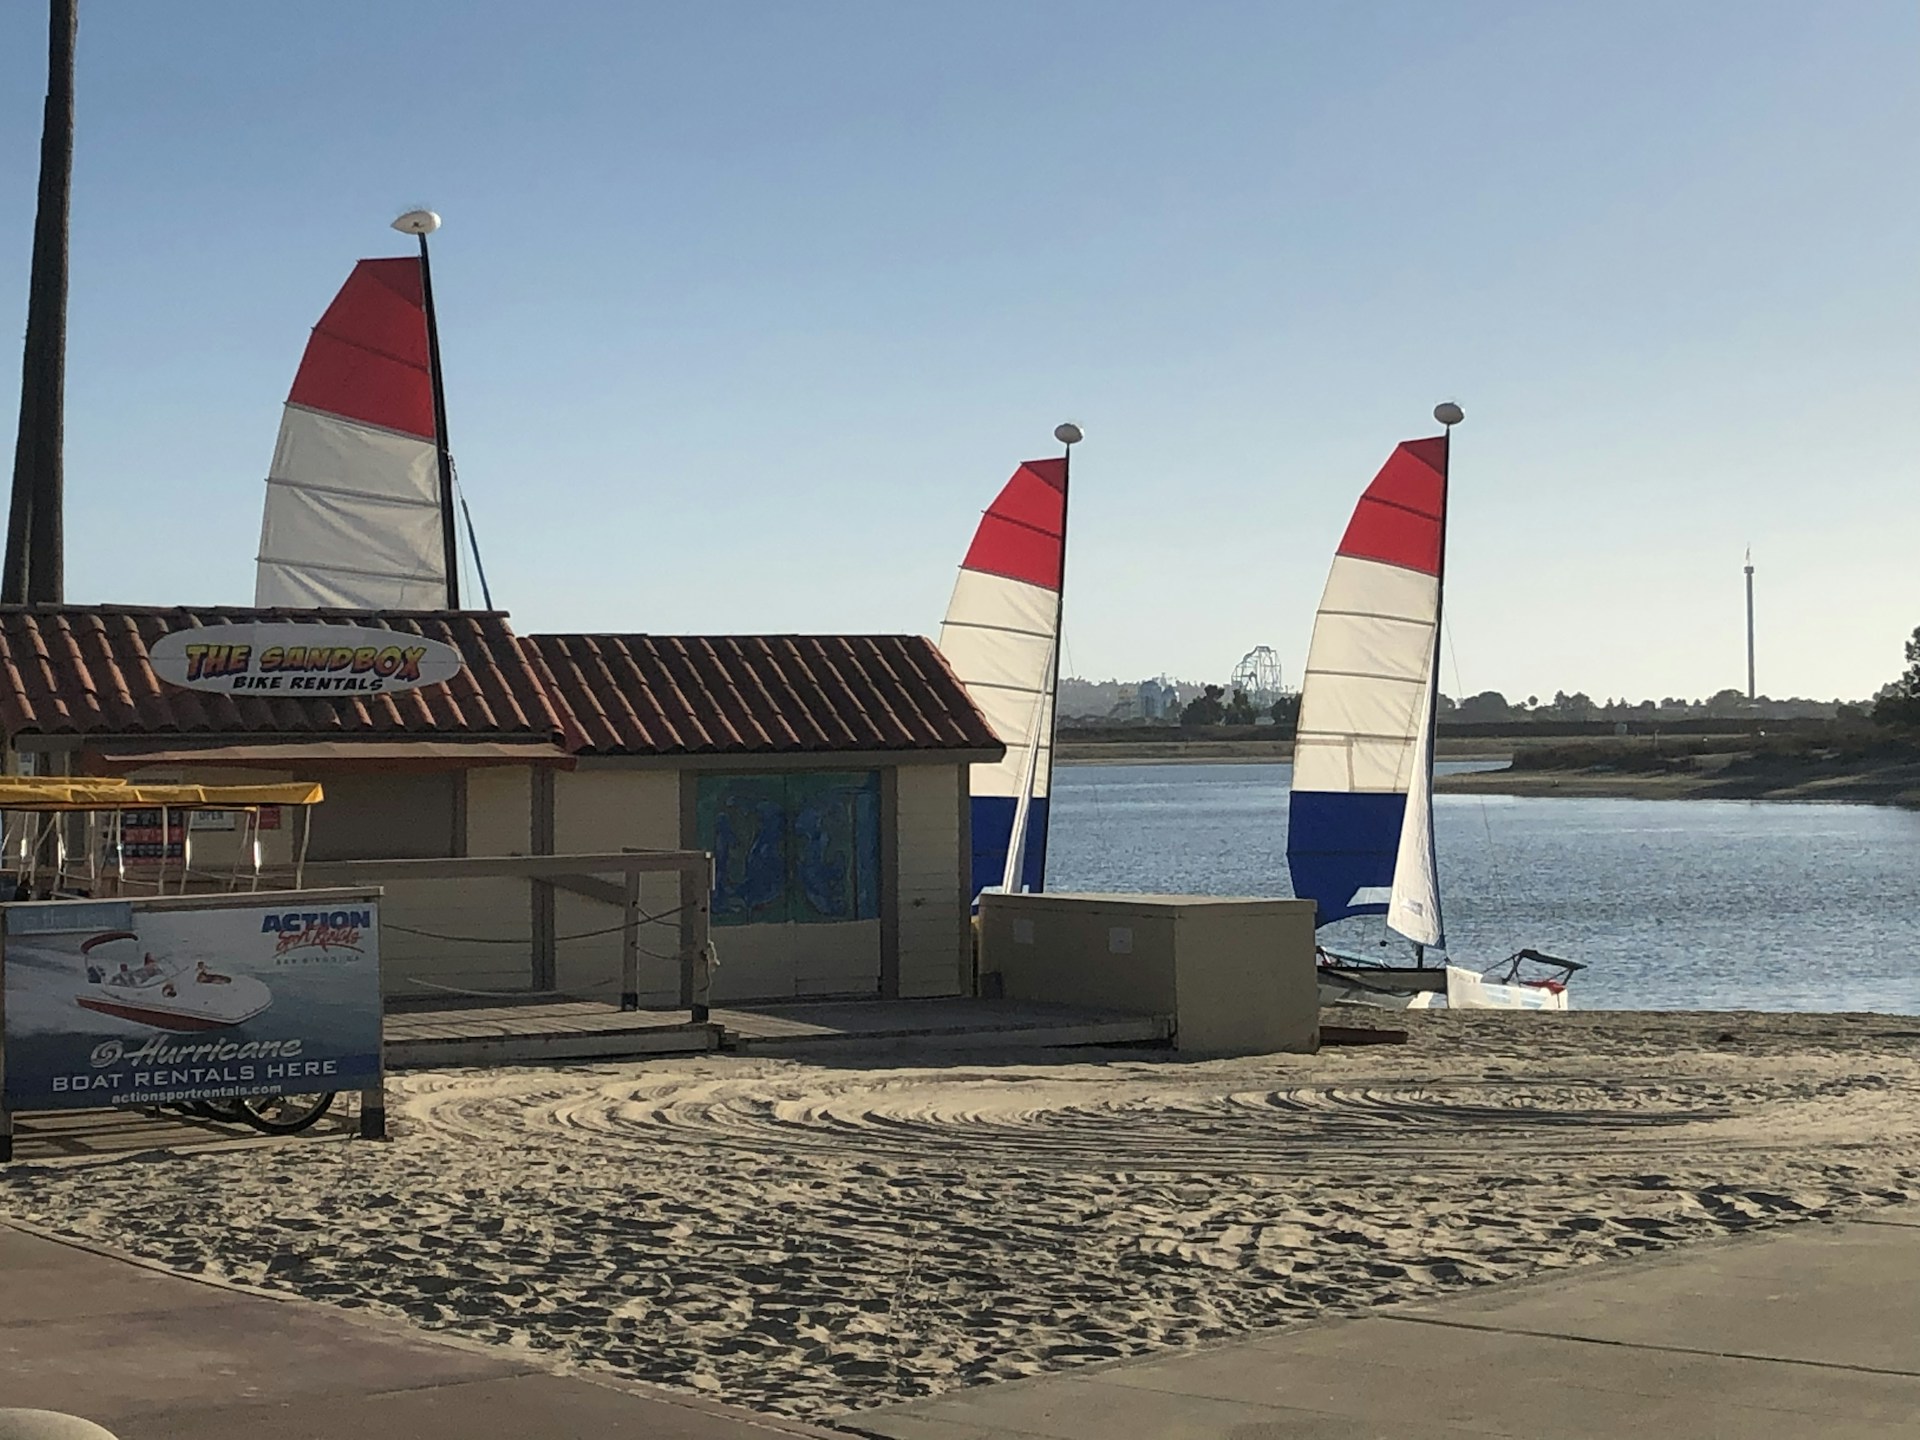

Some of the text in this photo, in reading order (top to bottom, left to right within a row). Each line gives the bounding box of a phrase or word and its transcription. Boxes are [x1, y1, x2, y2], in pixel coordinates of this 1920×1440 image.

[185, 644, 427, 681] THE SANDBOX
[233, 676, 384, 692] BIKE RENTALS
[261, 911, 370, 933] ACTION
[123, 1034, 303, 1067] Hurricane
[52, 1060, 337, 1092] BOAT RENTALS HERE
[112, 1083, 282, 1104] actionsportrentals.com
